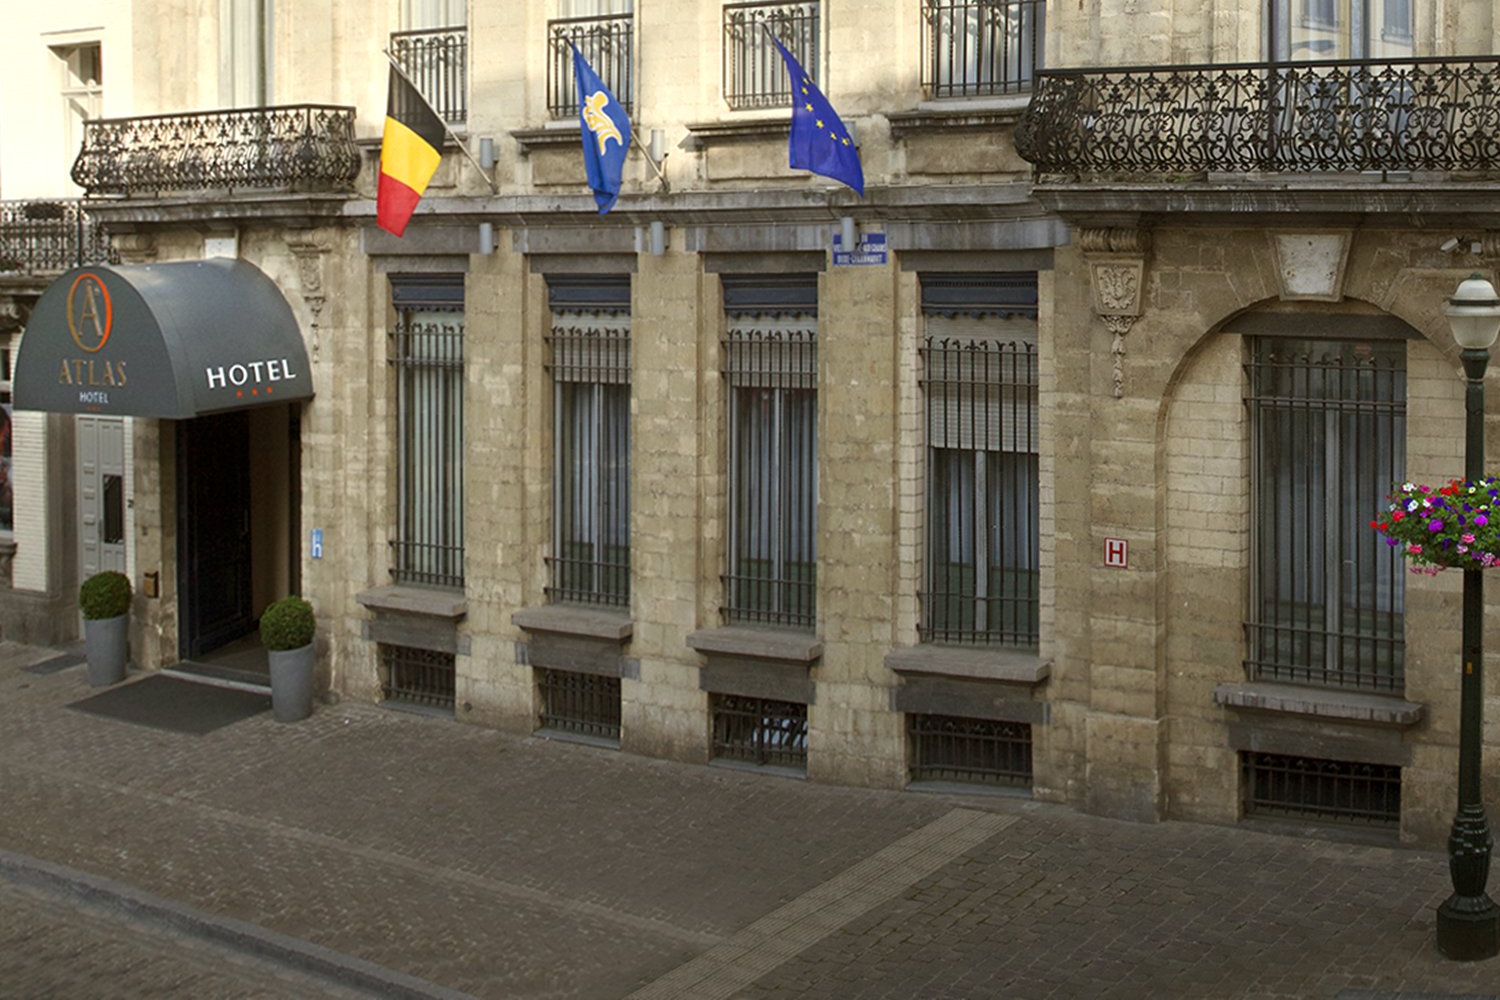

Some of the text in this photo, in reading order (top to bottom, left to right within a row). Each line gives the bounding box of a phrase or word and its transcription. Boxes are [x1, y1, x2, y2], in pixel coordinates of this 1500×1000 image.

[59, 359, 127, 387] ATLAS
[206, 359, 296, 389] HOTEL
[79, 391, 109, 404] HOTEL
[1109, 541, 1123, 564] H
